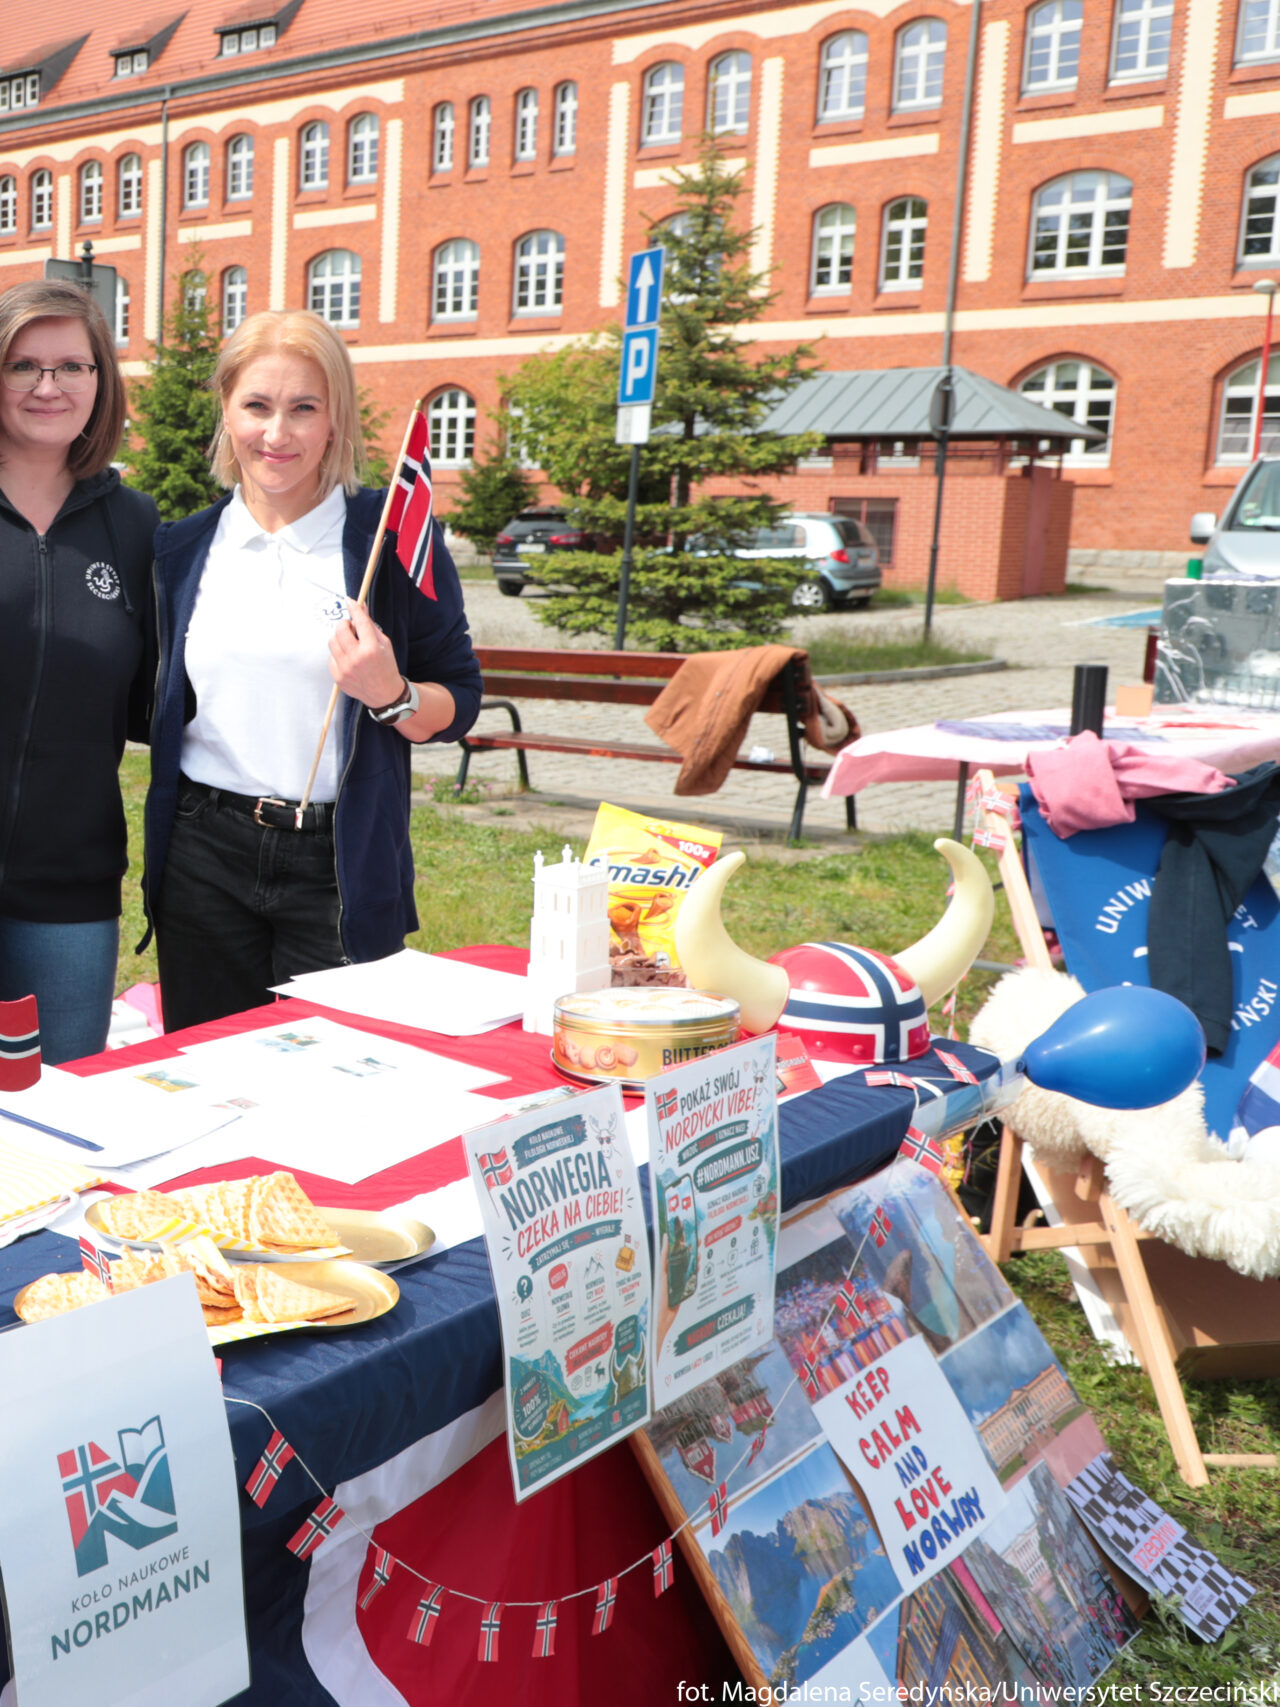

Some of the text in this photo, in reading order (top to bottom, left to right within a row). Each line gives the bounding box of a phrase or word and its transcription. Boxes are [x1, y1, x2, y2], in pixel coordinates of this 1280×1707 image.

[625, 336, 650, 397] P
[678, 840, 710, 858] 100g
[666, 1086, 757, 1153] NORDYCKI VIBE!
[681, 1067, 740, 1116] POKAŻ SWÓJ
[500, 1151, 612, 1230] NORWEGIA
[696, 1142, 760, 1187] #NORDMANN.USZ
[517, 1188, 624, 1258] CZEKA NA CIEBIE!
[717, 1304, 746, 1330] CZEKAJĄ!
[523, 1396, 541, 1417] 100%
[844, 1365, 891, 1421] KEEP
[860, 1405, 922, 1470] CALM
[896, 1444, 929, 1489] AND
[893, 1465, 952, 1533] LOVE
[902, 1486, 987, 1578] NORWAY
[51, 1559, 211, 1660] NORDMANN
[71, 1545, 190, 1614] KOŁO NAUKOWE
